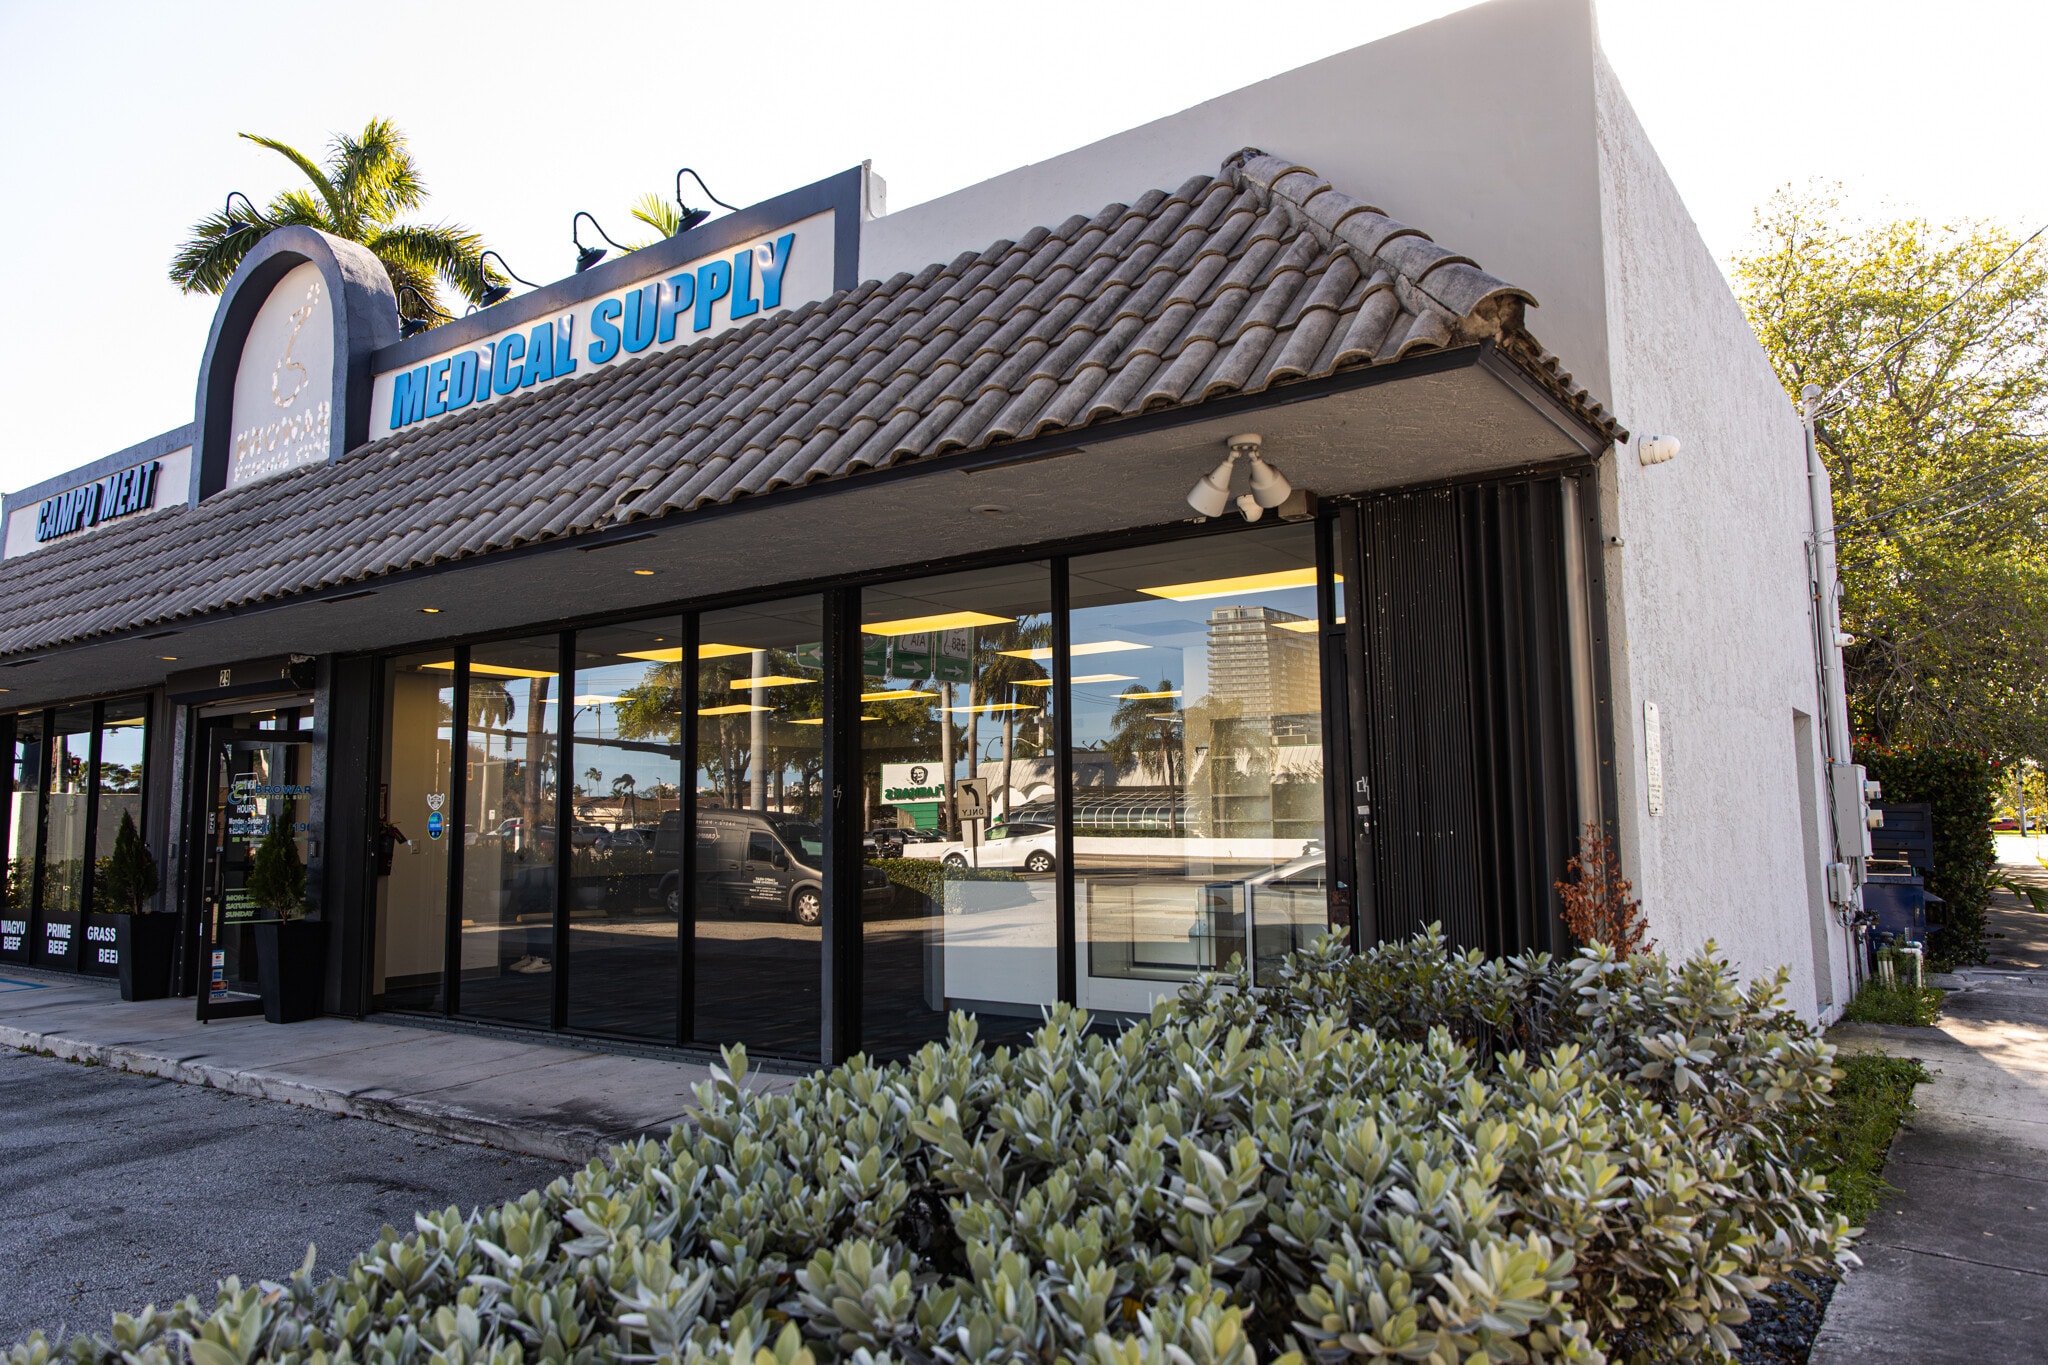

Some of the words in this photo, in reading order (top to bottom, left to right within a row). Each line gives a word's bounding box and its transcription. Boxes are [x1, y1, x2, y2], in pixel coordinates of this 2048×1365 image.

[390, 314, 577, 429] MEDICAL
[588, 233, 796, 364] SUPPLY
[35, 483, 99, 542] CAMPO
[99, 461, 160, 521] MEAT
[220, 670, 231, 687] 29
[236, 804, 256, 814] HOURS
[225, 910, 254, 918] SUNDAY
[1, 920, 26, 935] WAGYU
[47, 922, 72, 939] PRIME
[87, 926, 116, 943] GRASS
[3, 936, 21, 951] BEEF
[48, 940, 68, 955] BEEF
